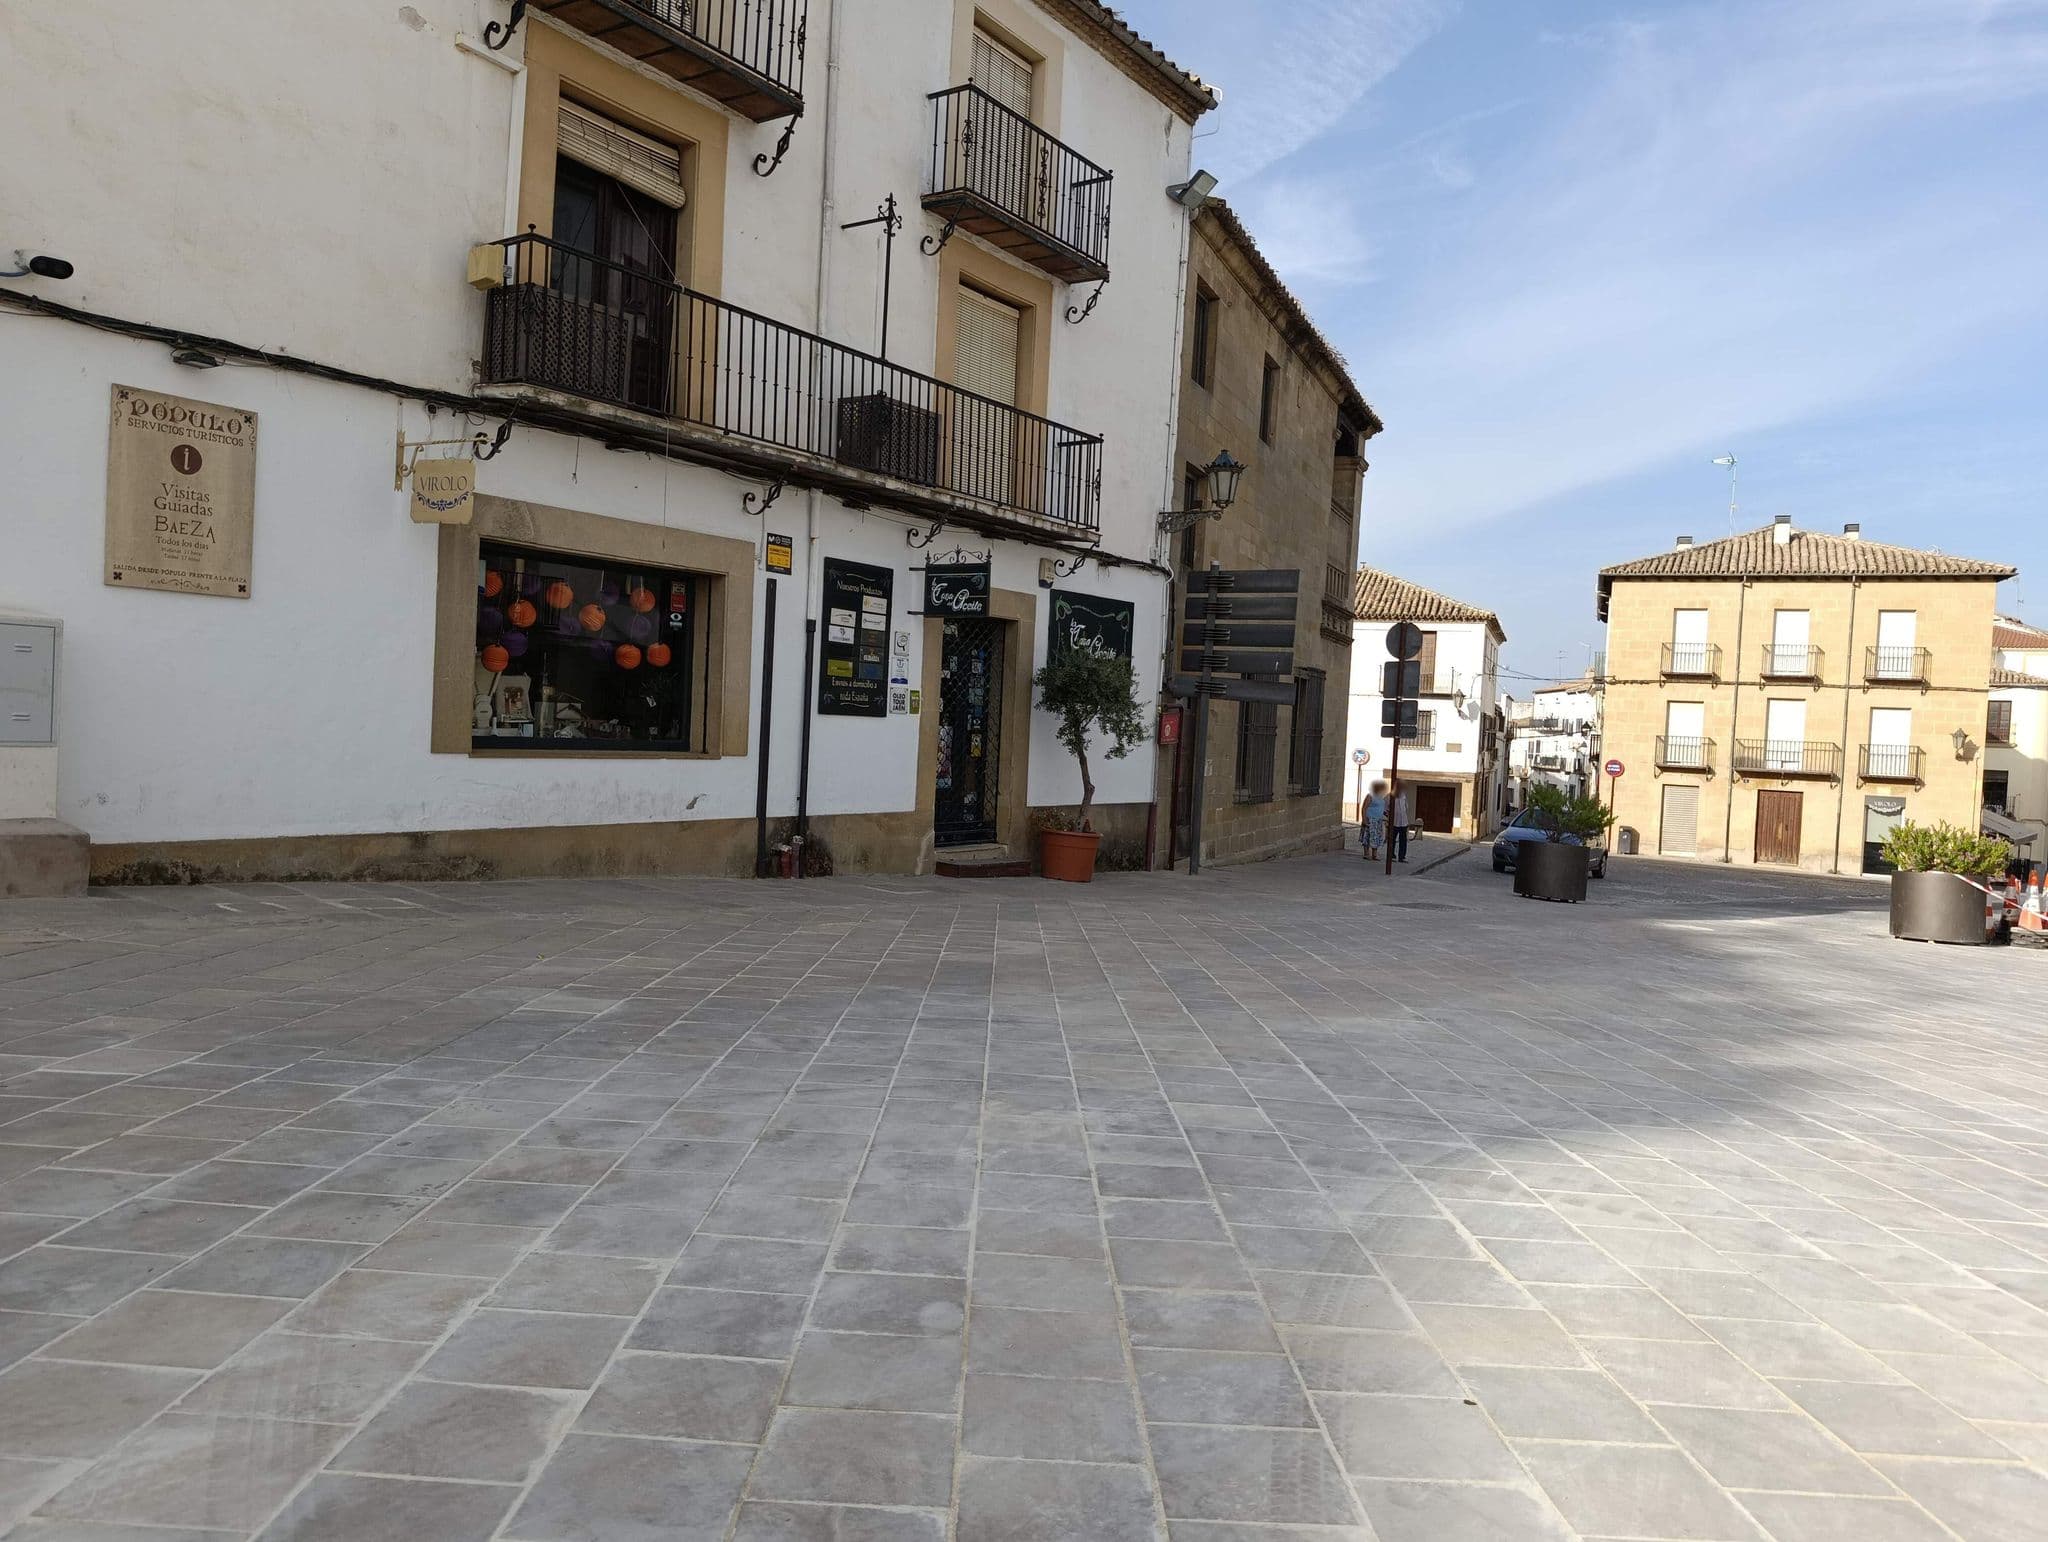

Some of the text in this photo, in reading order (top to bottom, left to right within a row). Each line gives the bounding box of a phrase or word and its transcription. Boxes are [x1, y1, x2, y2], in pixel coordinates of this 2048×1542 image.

[127, 416, 185, 437] SERVICIOS
[131, 399, 242, 435] PÓPULO
[160, 483, 210, 502] Visitas
[420, 475, 468, 492] VIROLO
[153, 496, 213, 516] Guiadas
[153, 515, 217, 544] BAEZA
[155, 535, 180, 547] Todos
[182, 539, 193, 548] los
[112, 563, 137, 572] SALIDA
[138, 566, 159, 574] DESDE
[189, 571, 213, 580] FRENTE
[228, 576, 248, 584] PLAZA
[837, 580, 883, 597] Nuestros Productos
